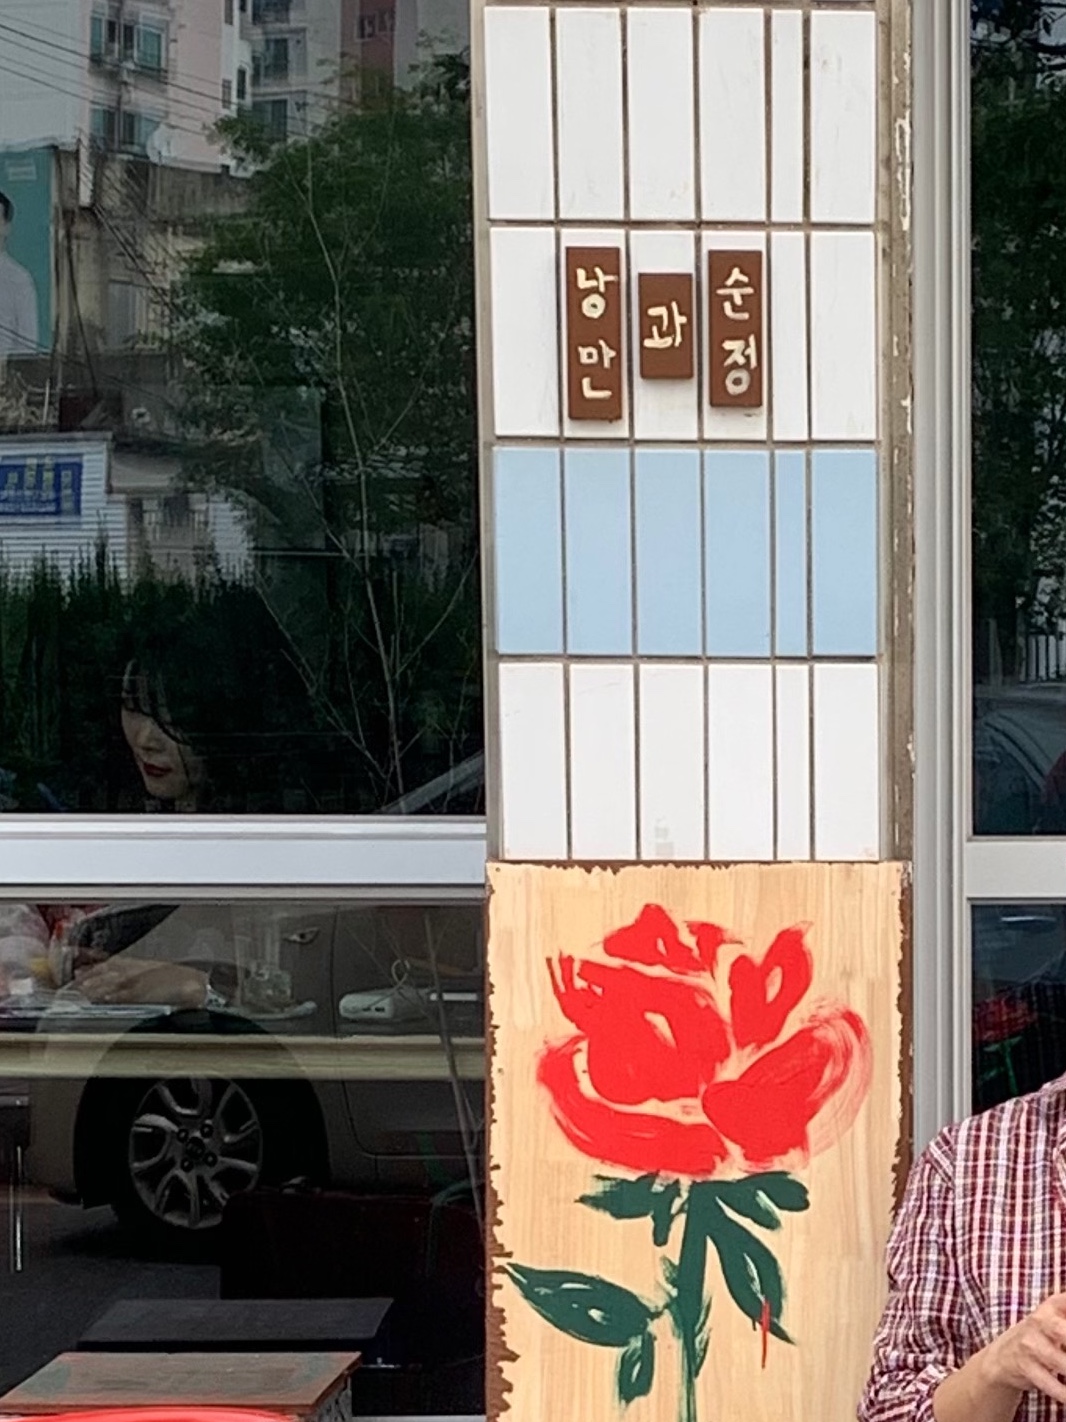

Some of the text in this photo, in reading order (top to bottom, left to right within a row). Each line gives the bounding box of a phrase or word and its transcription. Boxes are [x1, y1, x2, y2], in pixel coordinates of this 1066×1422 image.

[575, 266, 758, 400] 낭만 과 순정
